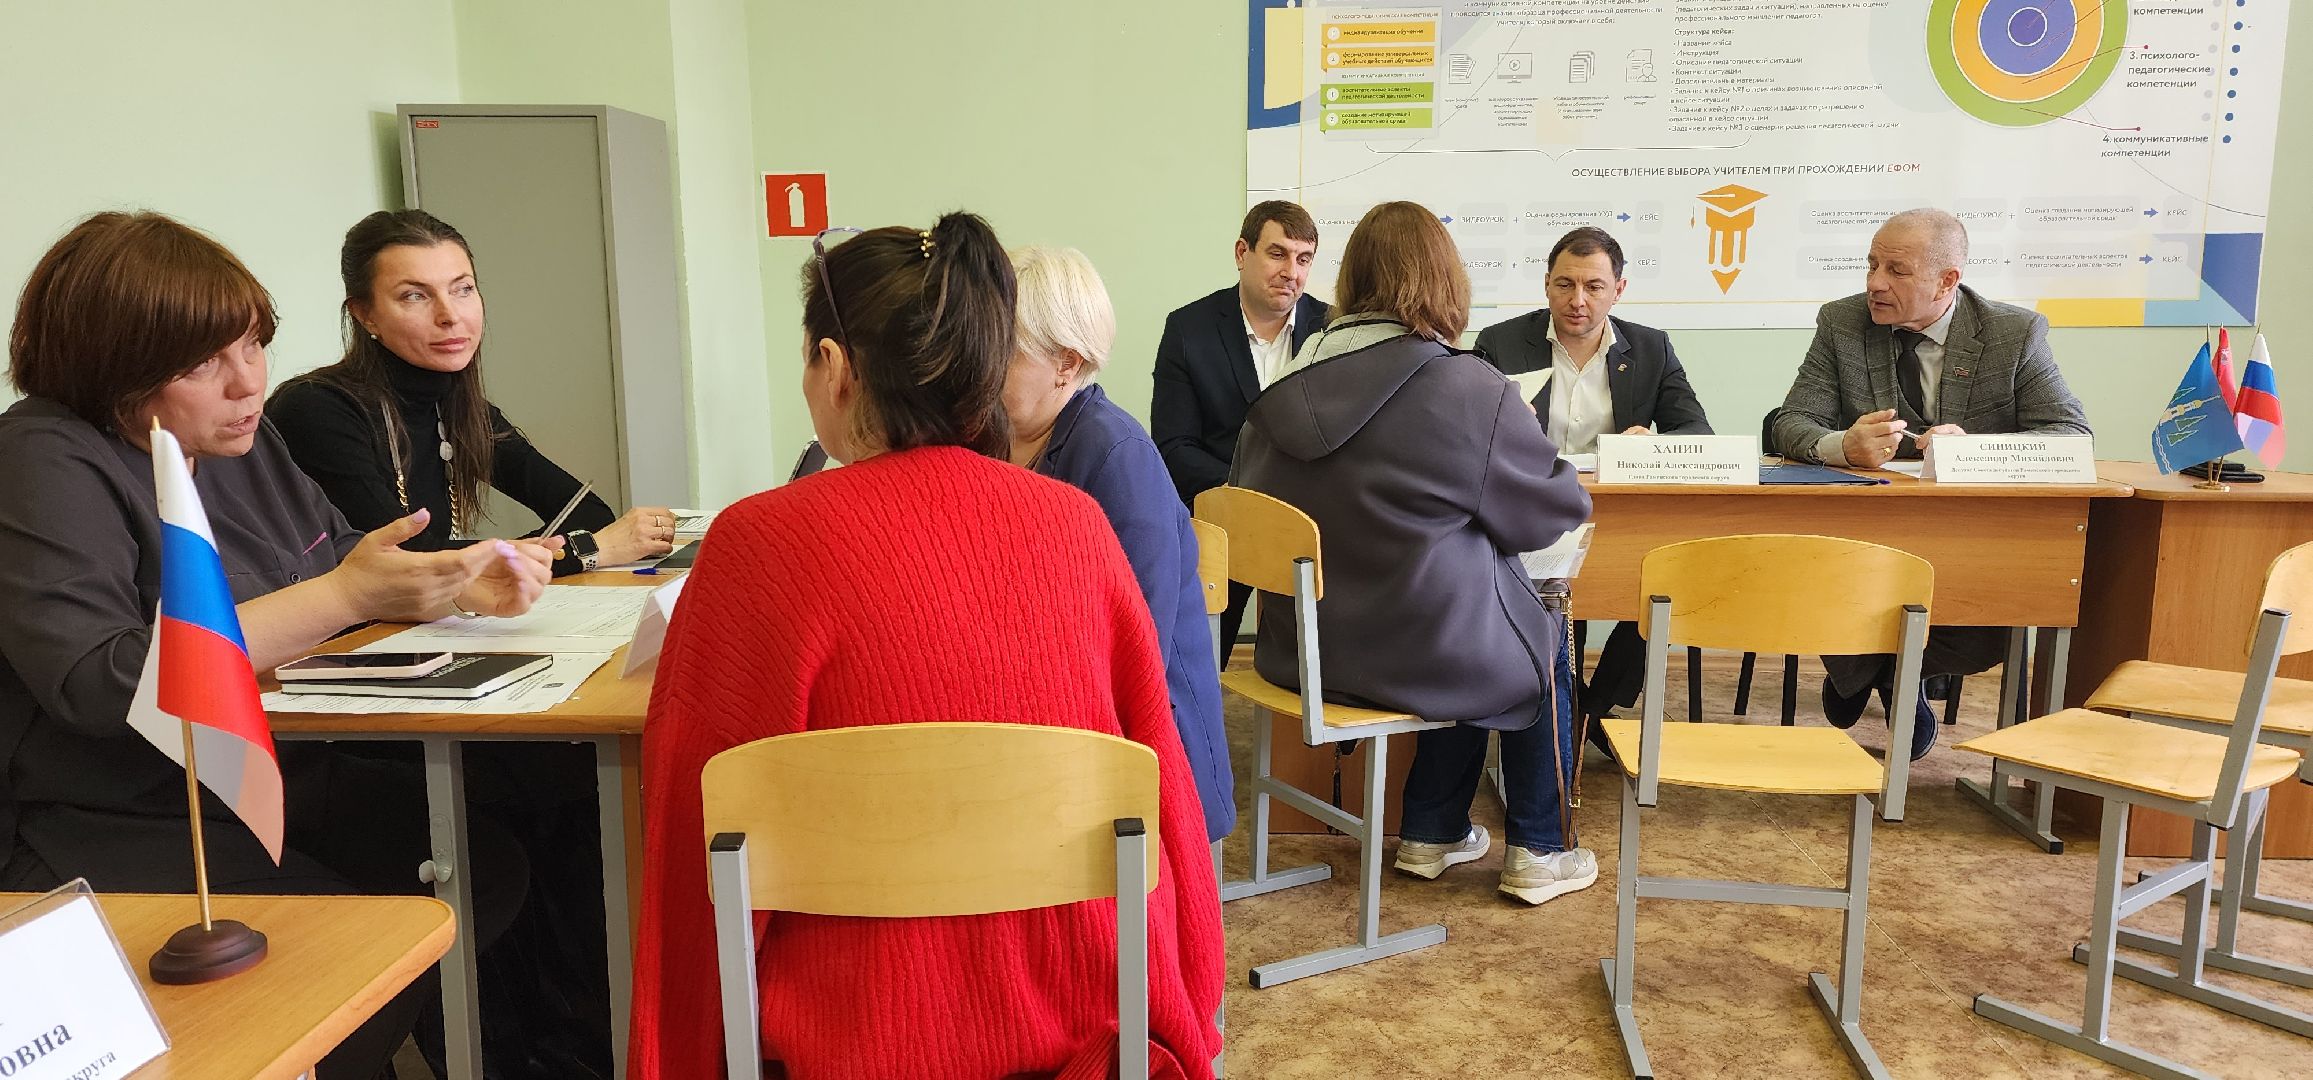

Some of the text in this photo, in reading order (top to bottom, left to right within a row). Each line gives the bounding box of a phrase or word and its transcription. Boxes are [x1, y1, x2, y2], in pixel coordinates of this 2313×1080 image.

[2133, 8, 2204, 16] компетенции
[2129, 51, 2200, 61] 3. психолого-
[2128, 65, 2211, 76] педагогические
[2126, 79, 2197, 89] компетенции
[2102, 134, 2209, 145] 4. коммуникативные
[2101, 147, 2171, 158] компетенции
[1571, 163, 1920, 178] ОСУЩЕСТВЛЕНИЕ ВЫБОРА УЧИТЕЛЕМ ПРИ ПРОХОЖДЕНИИ ЕФОМ
[1461, 216, 1504, 224] ВИДЕОУРОК
[1639, 213, 1659, 221] КЕЙС
[1956, 211, 2003, 220] ВИДЕОУРОК
[1652, 444, 1703, 454] ХАНИН
[1979, 441, 2047, 452] СИНИЦКИЙ
[1954, 454, 2075, 465] Александр Михайлович
[1617, 460, 1741, 471] Николай Александрович
[66, 1051, 116, 1080] круга
